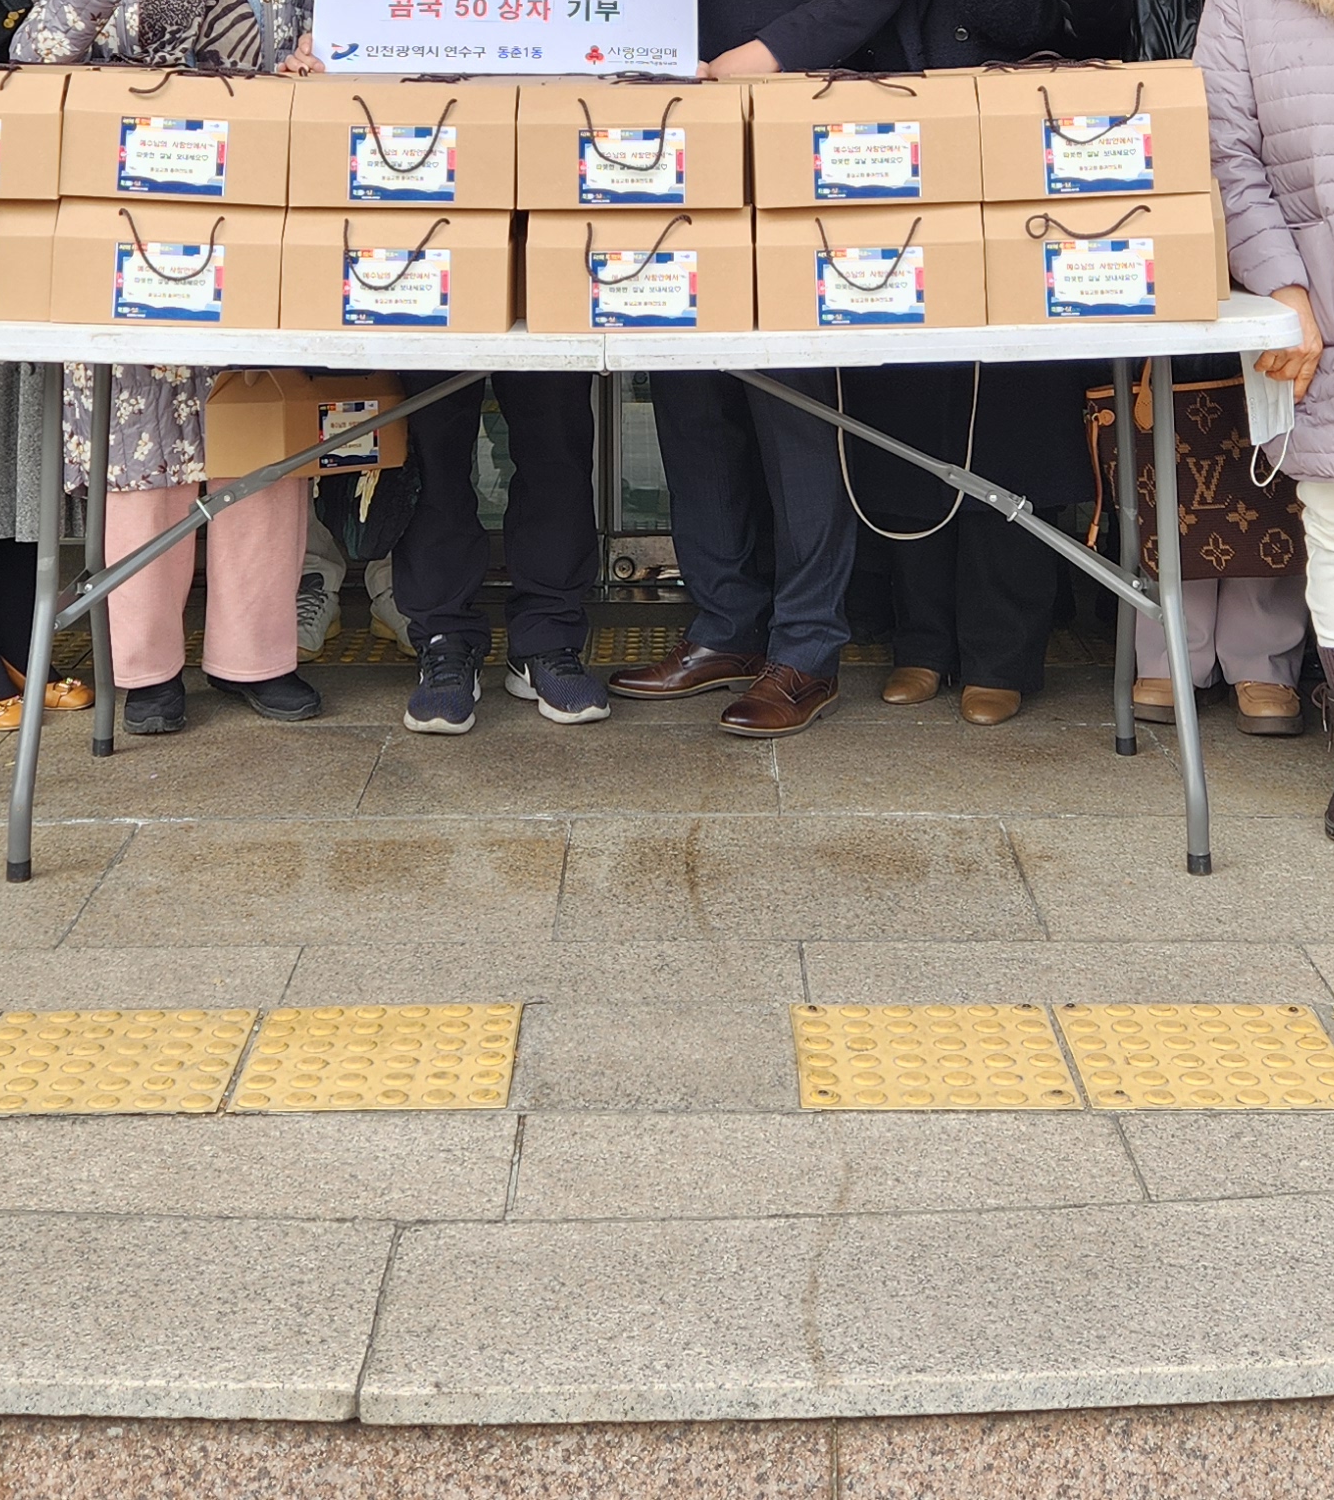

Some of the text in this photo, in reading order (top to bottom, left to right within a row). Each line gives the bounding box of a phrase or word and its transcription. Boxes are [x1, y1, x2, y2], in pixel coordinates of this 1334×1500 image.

[365, 44, 543, 60] 인천광역시 연수구 동춘1동
[607, 45, 678, 60] 사랑의열매
